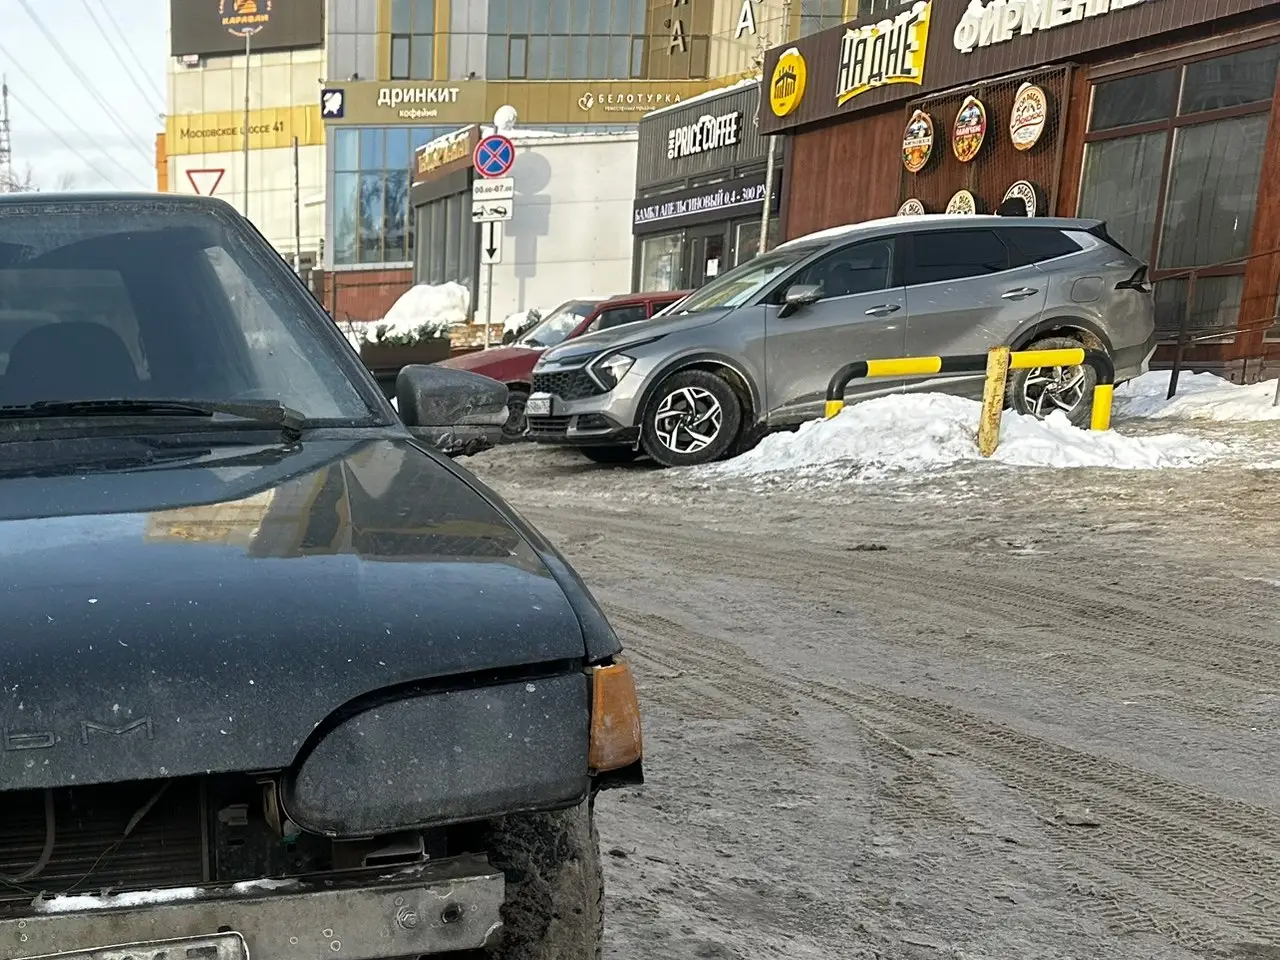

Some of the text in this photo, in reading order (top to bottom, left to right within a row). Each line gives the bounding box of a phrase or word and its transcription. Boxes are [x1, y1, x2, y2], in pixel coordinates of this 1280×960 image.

[836, 14, 923, 96] НА ДНЕ
[598, 93, 681, 104] БЕЛОТУРКА
[399, 108, 437, 119] кофейня
[273, 120, 284, 133] 41
[674, 122, 702, 158] PRICE
[702, 111, 739, 150] COFFEE
[659, 189, 724, 217] АПЕЛЬСИНОВЫЙ
[742, 186, 756, 201] 300
